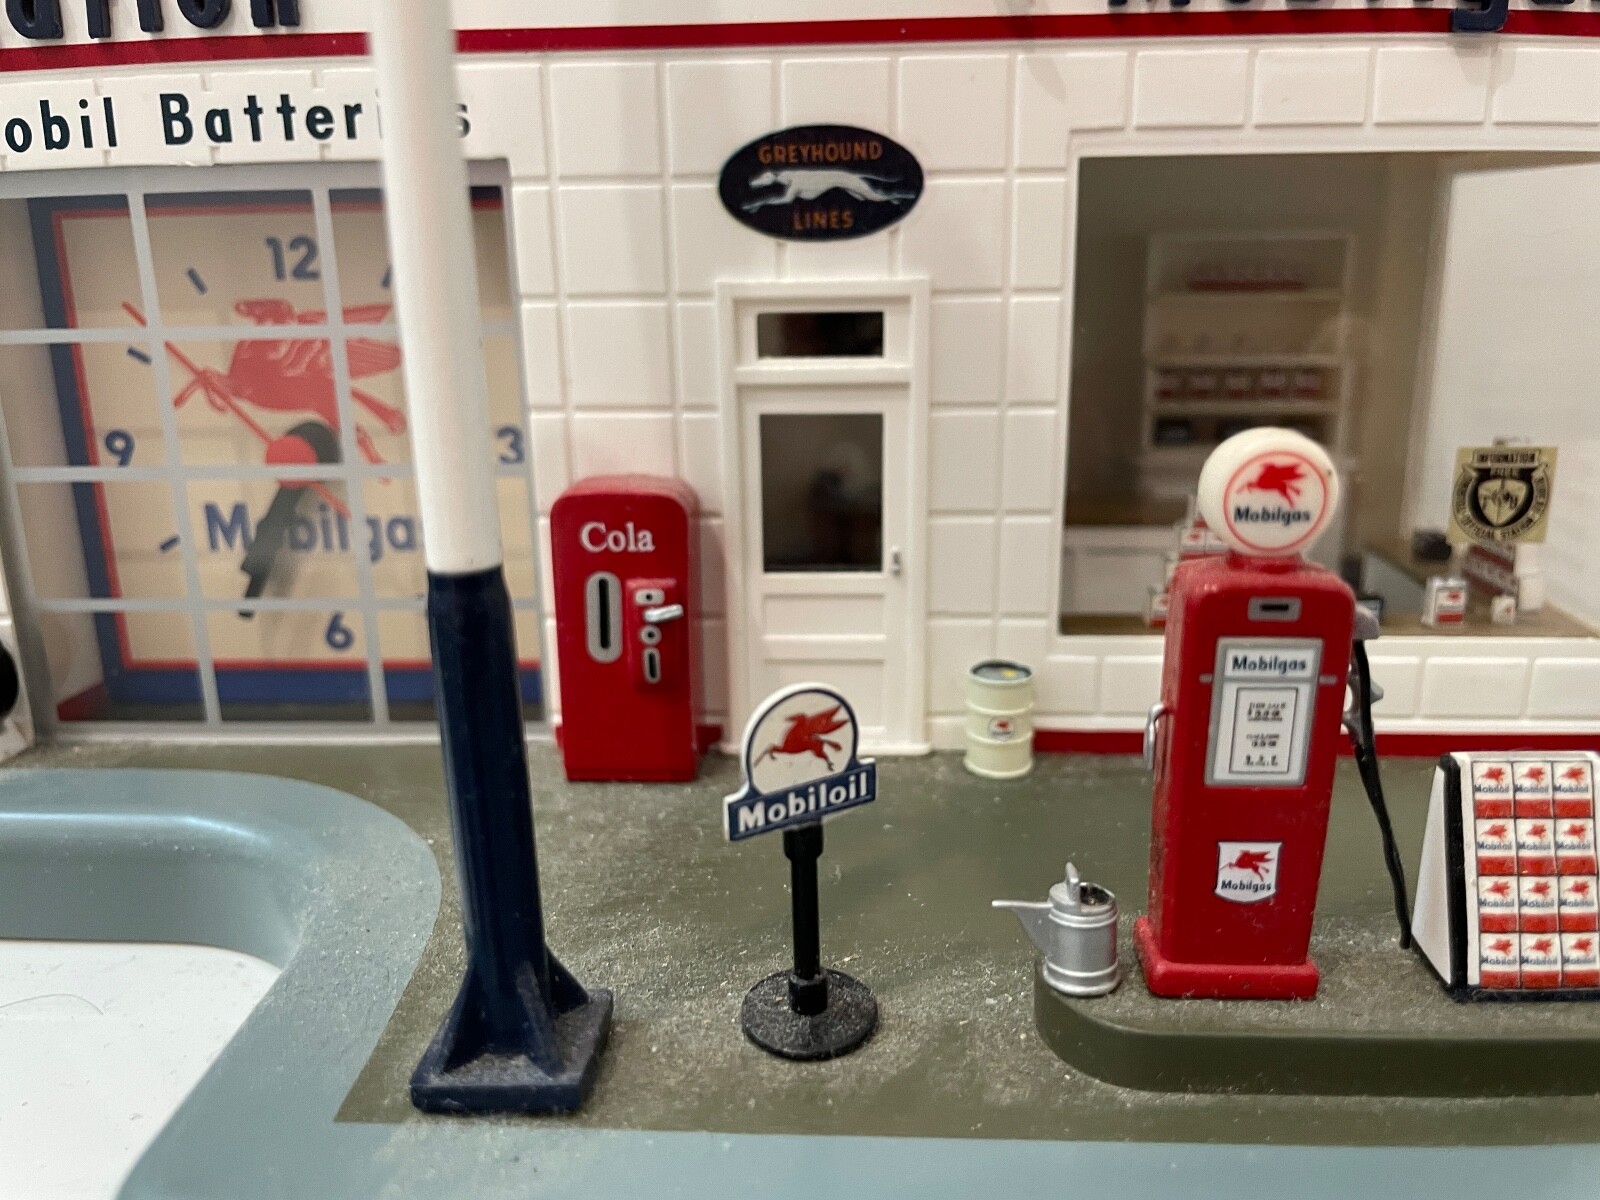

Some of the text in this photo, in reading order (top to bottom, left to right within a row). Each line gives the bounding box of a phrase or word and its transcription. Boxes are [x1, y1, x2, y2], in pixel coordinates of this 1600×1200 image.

[160, 92, 471, 145] Batters
[757, 140, 884, 165] GREYHOUND
[792, 209, 854, 230] LINES
[266, 235, 320, 281] 12
[105, 429, 135, 468] 9
[497, 426, 525, 465] 3
[1234, 505, 1310, 527] Mobilgas
[579, 520, 656, 553] Cola
[325, 611, 355, 651] 6
[1231, 654, 1307, 675] Mobilgas
[738, 771, 868, 833] Mobiloil
[1220, 880, 1272, 893] Mobilgas
